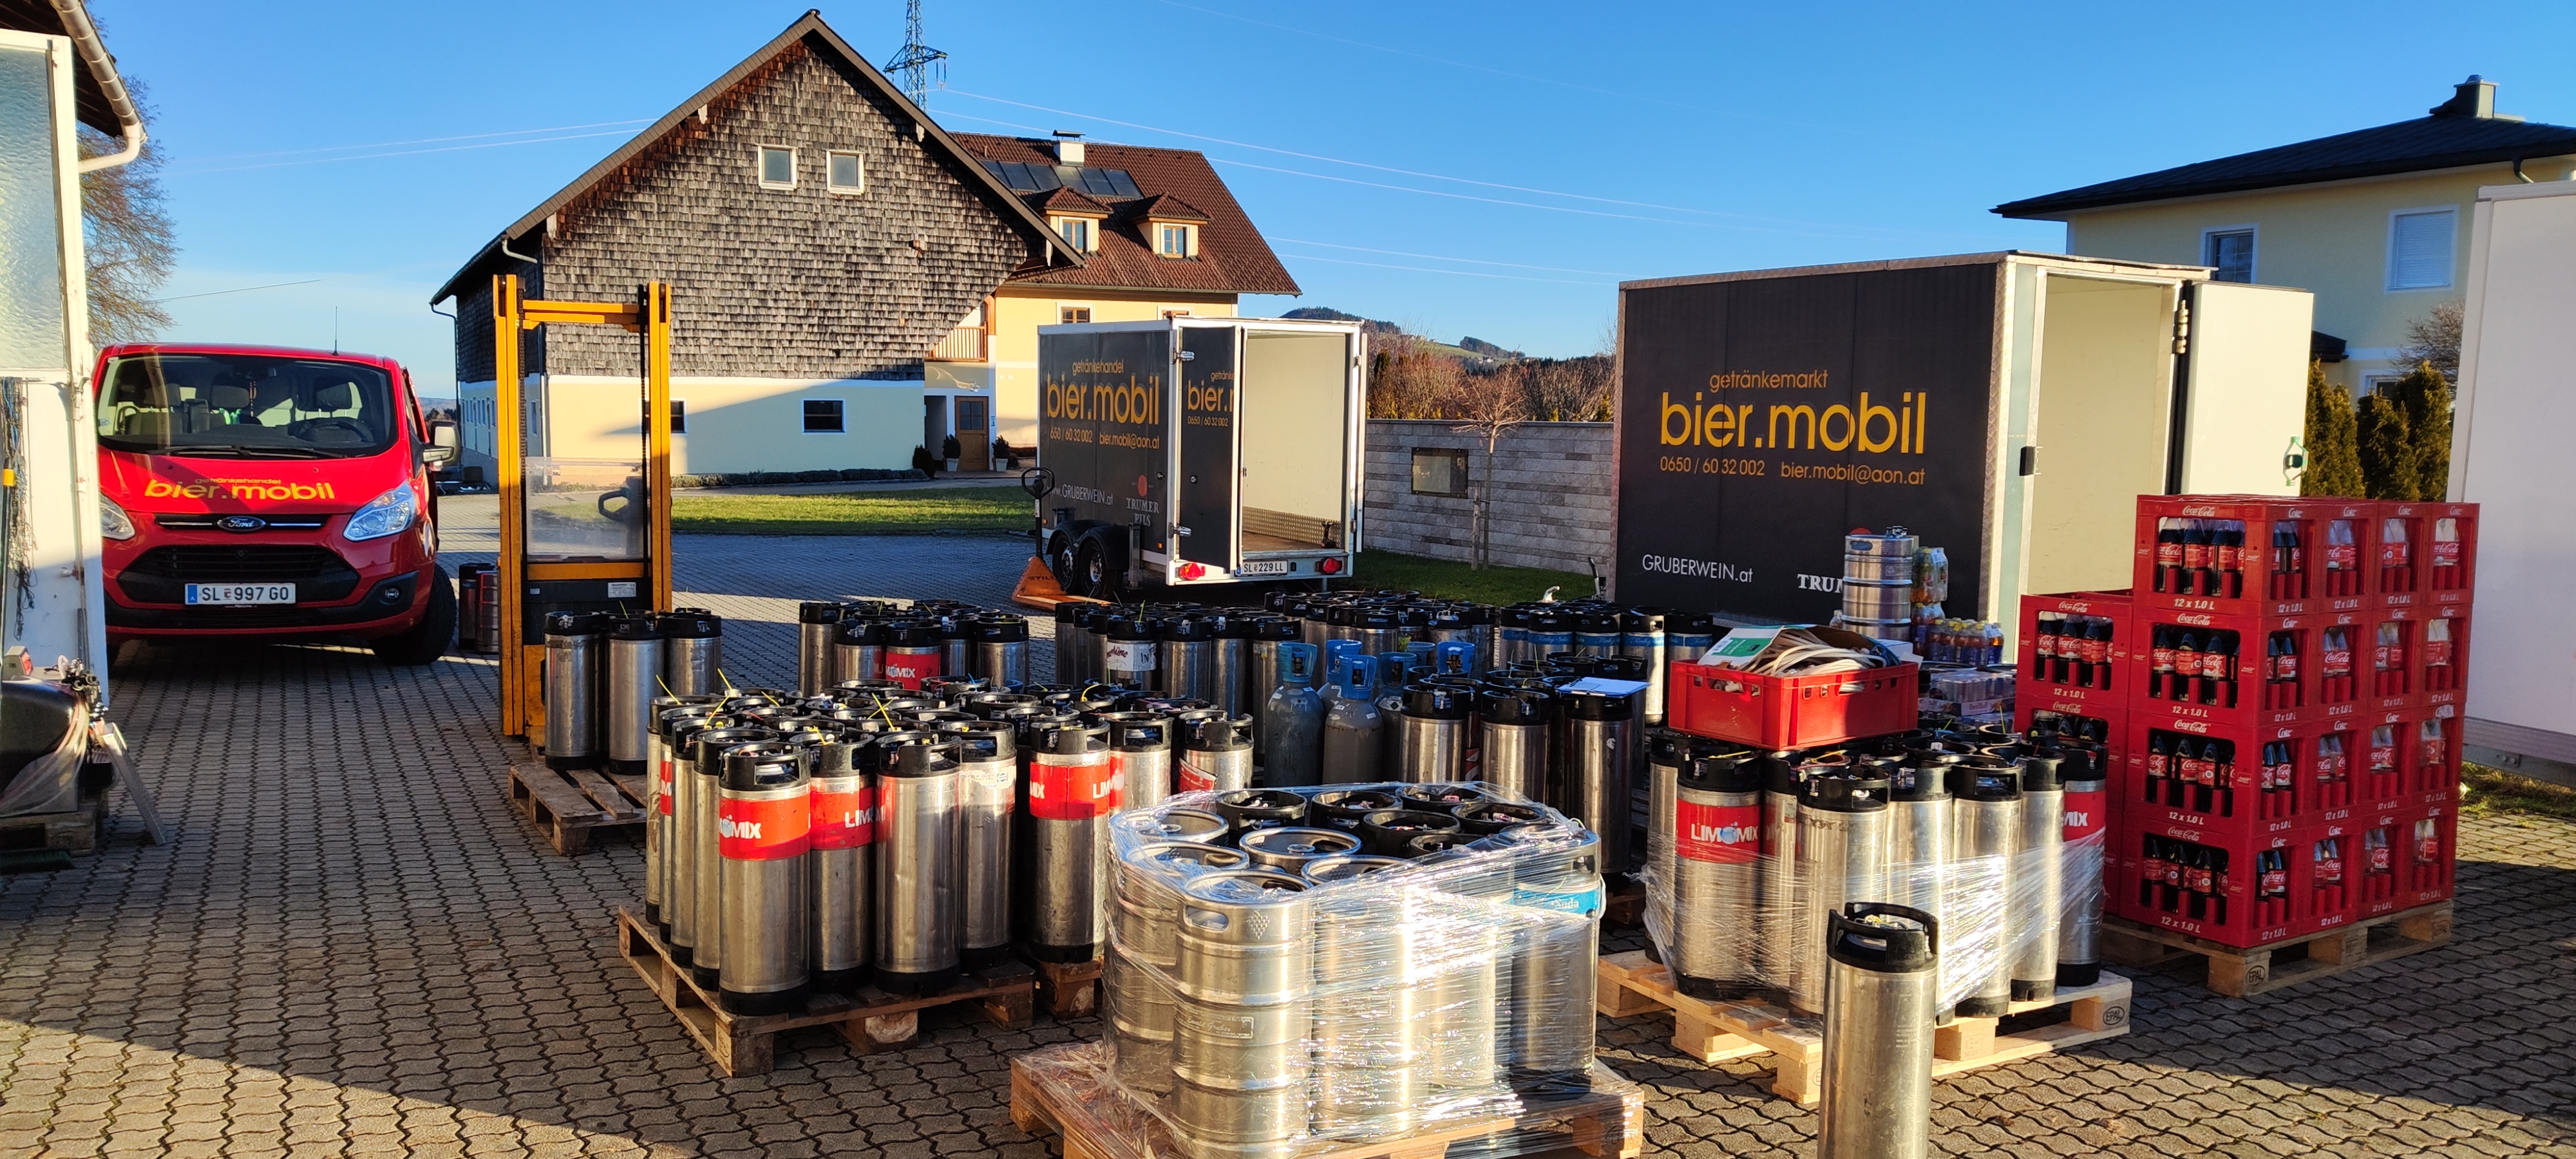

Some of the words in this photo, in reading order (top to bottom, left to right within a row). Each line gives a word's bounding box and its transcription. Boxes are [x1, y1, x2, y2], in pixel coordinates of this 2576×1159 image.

[1072, 359, 1124, 376] getränkehandel
[1211, 370, 1235, 382] getränke
[1709, 370, 1828, 393] getränkemarkt
[1047, 372, 1159, 425] bier.mobil
[1188, 415, 1200, 425] 0650
[1660, 391, 1926, 454] bier.mobil
[1099, 431, 1159, 449] bier.mobil@aon.at
[1660, 456, 1692, 473] 0650
[1694, 457, 1699, 475] /
[1703, 457, 1719, 474] 60
[1721, 458, 1737, 475] 32
[1739, 459, 1765, 476] 002
[1780, 461, 1926, 485] bier.mobil@aon.at
[144, 479, 335, 500] bier.mobil
[1126, 497, 1159, 514] TRUMER
[227, 518, 254, 527] Ford
[1244, 563, 1253, 572] SL
[1258, 563, 1273, 572] 229
[1275, 563, 1283, 572] LL
[1642, 554, 1754, 583] GRUBERWEIN.at
[202, 587, 220, 601] SL
[234, 587, 265, 601] 997
[2174, 598, 2184, 607] 12
[2195, 600, 2208, 609] 1.0
[2334, 600, 2341, 609] 12
[2388, 596, 2394, 605] 12
[2278, 604, 2286, 613] 12
[2069, 690, 2079, 698] 1.0
[2432, 694, 2437, 702] 12
[2190, 708, 2202, 717] 1.0
[2275, 713, 2281, 721] 12
[2329, 707, 2335, 715] 12
[2169, 811, 2177, 820] 12
[2186, 814, 2197, 824] 1.0
[2325, 812, 2331, 820] 12
[2270, 823, 2276, 831] 12
[2161, 916, 2172, 925] 12
[2181, 921, 2194, 930] 1.0
[2262, 932, 2268, 940] 12
[2249, 969, 2265, 981] EPAL
[2106, 1010, 2123, 1022] EPAL
